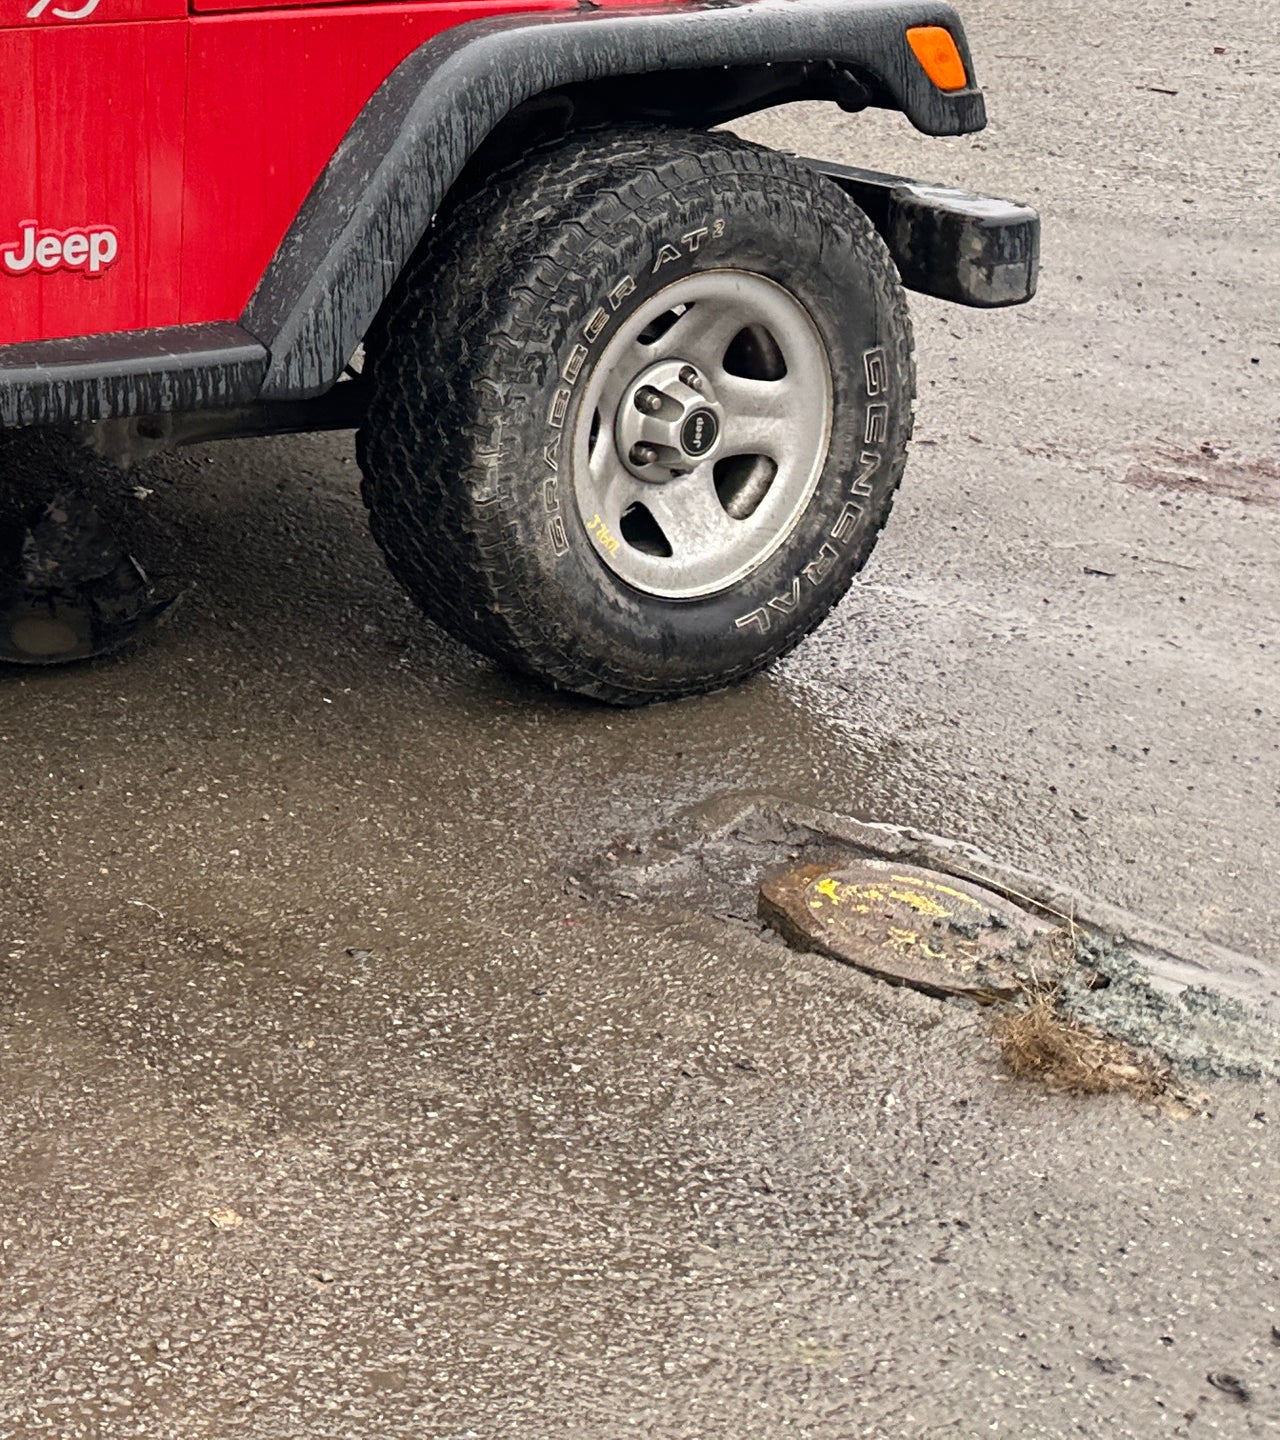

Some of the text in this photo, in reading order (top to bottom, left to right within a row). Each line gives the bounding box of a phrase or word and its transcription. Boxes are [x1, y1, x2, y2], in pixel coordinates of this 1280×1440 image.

[4, 227, 117, 271] Jeep
[544, 275, 637, 557] GRABBER
[692, 417, 705, 448] Jeep
[735, 347, 889, 635] GENERAL
